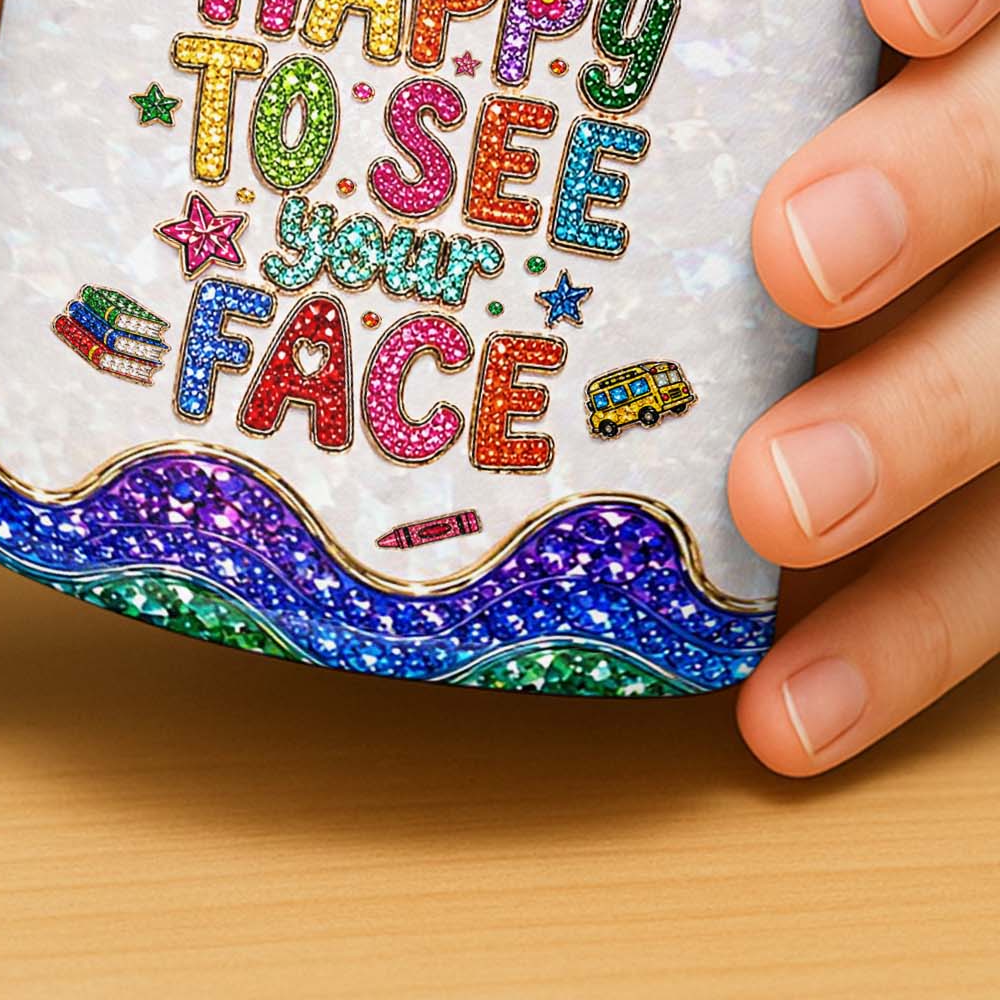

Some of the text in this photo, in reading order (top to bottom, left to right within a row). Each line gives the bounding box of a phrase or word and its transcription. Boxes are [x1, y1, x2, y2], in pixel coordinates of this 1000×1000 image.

[171, 31, 652, 258] TO SEE
[260, 195, 505, 308] your
[173, 278, 569, 474] FACE
